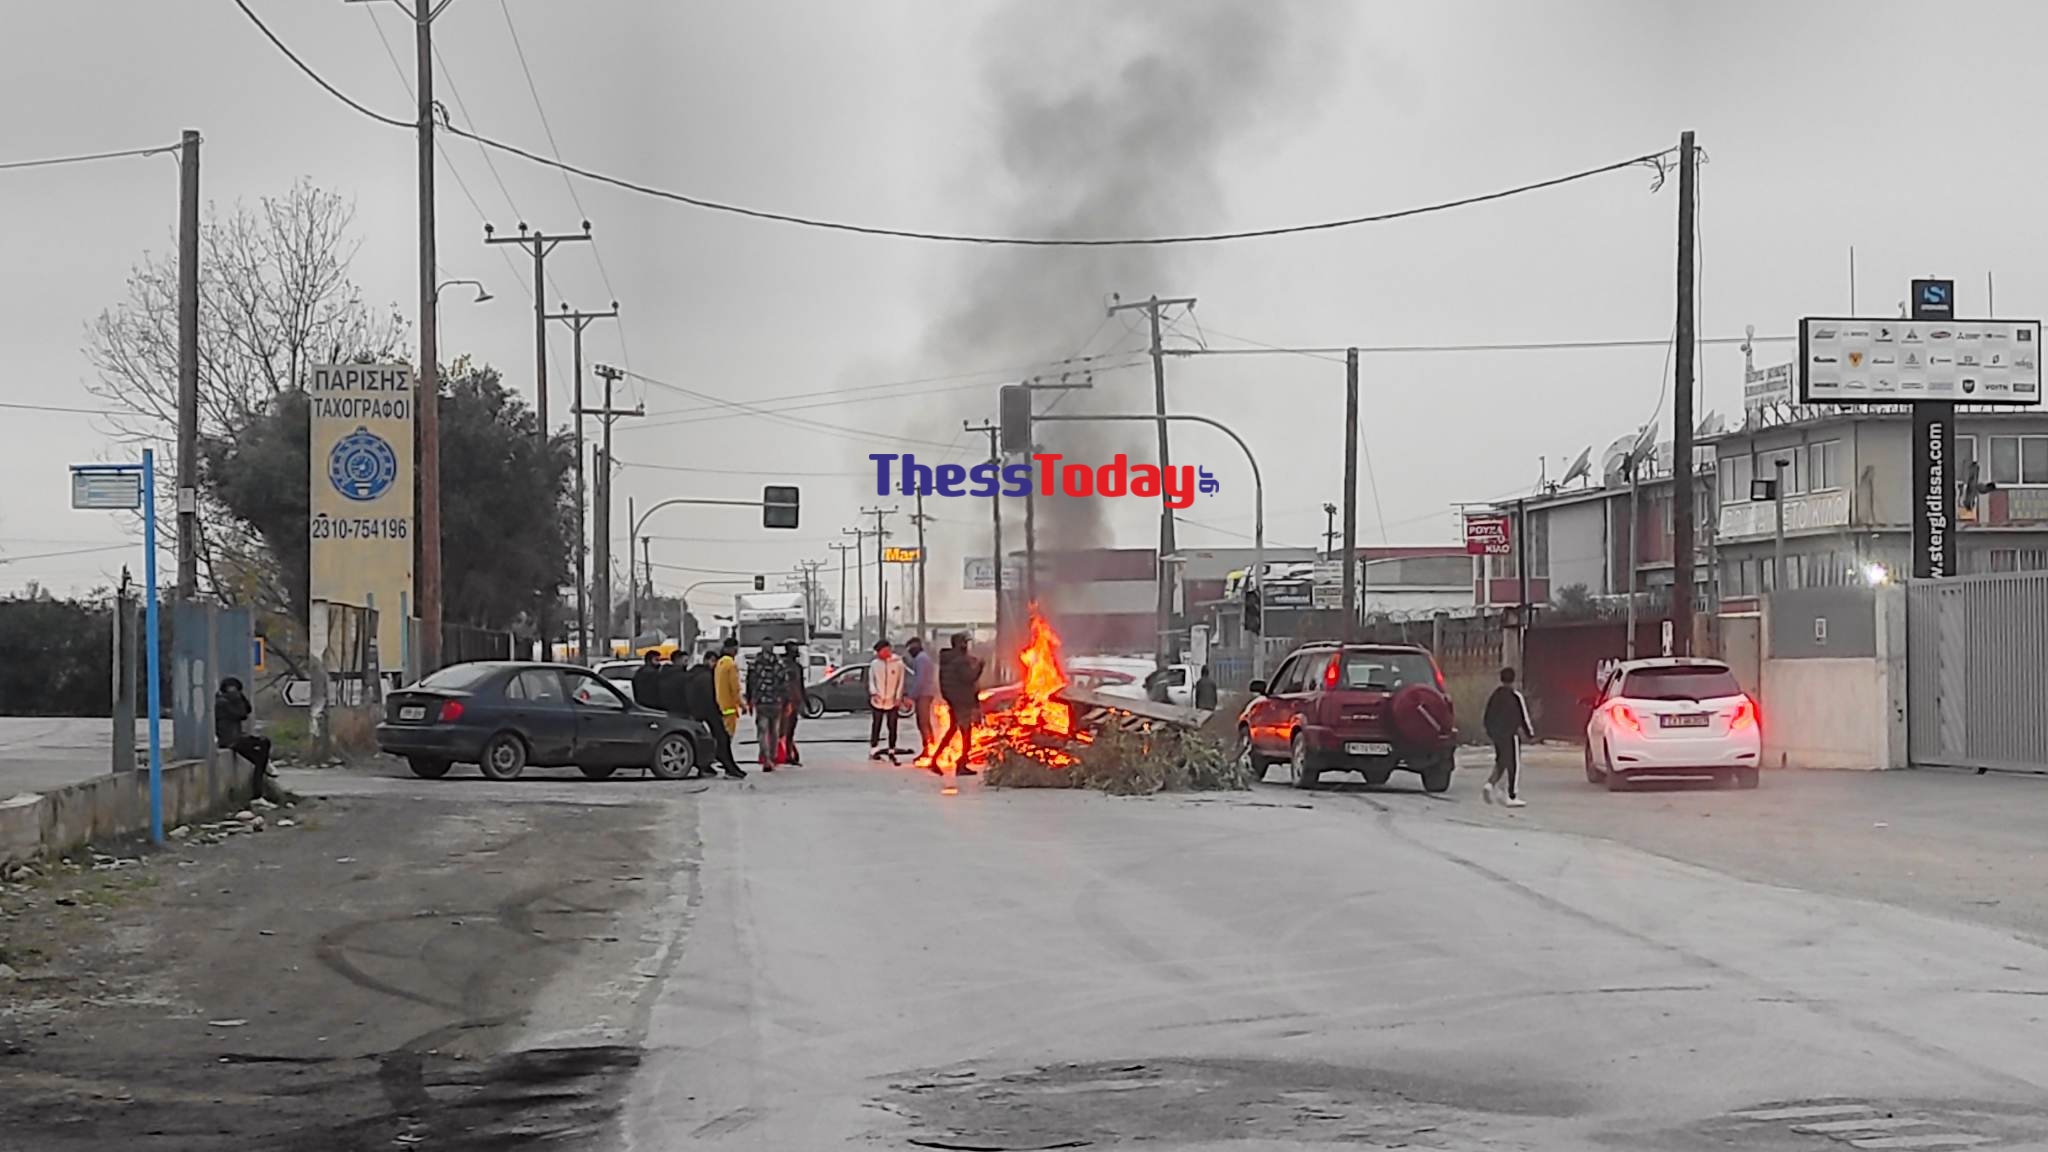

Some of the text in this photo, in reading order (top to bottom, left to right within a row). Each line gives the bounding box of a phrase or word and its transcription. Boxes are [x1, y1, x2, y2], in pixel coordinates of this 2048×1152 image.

[315, 370, 409, 391] ΠΑΡΙΣΗΣ
[314, 398, 409, 419] ΤΑΧΟΓΡΑΦΟΙ
[312, 519, 407, 539] 2310-754196
